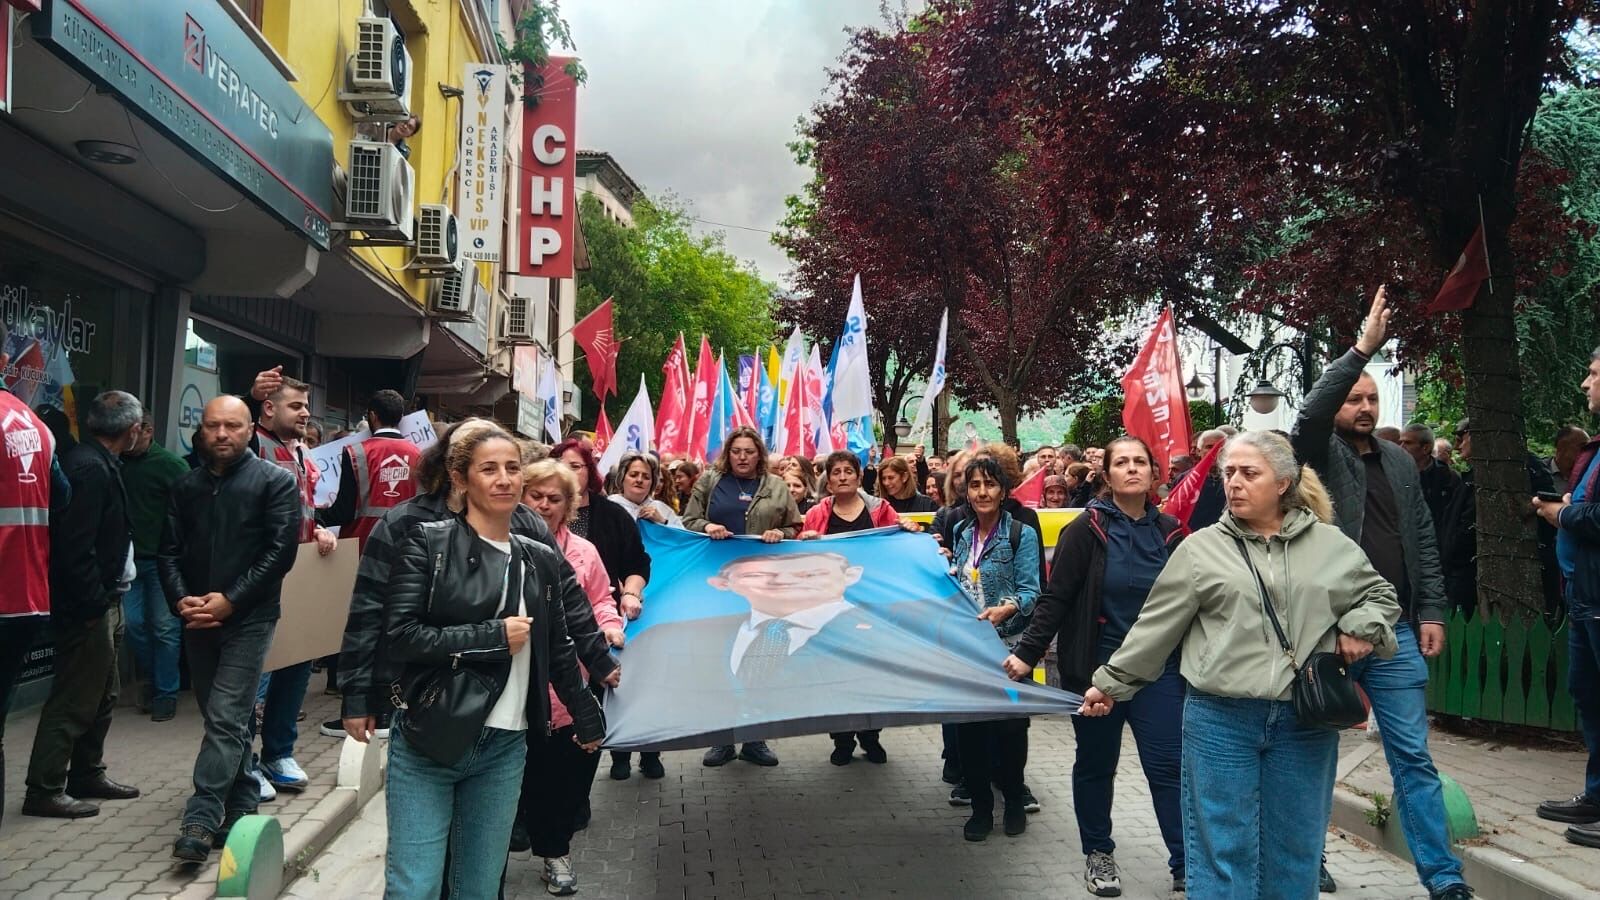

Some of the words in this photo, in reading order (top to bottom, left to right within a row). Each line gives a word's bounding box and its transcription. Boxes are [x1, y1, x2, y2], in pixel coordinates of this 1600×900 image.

[64, 13, 137, 88] KÜÇÜKAYLAR
[206, 43, 279, 140] VERATEC
[475, 111, 487, 213] NEKSUS
[530, 124, 566, 266] CHP
[470, 216, 489, 231] VİP
[0, 285, 96, 361] ükaylar
